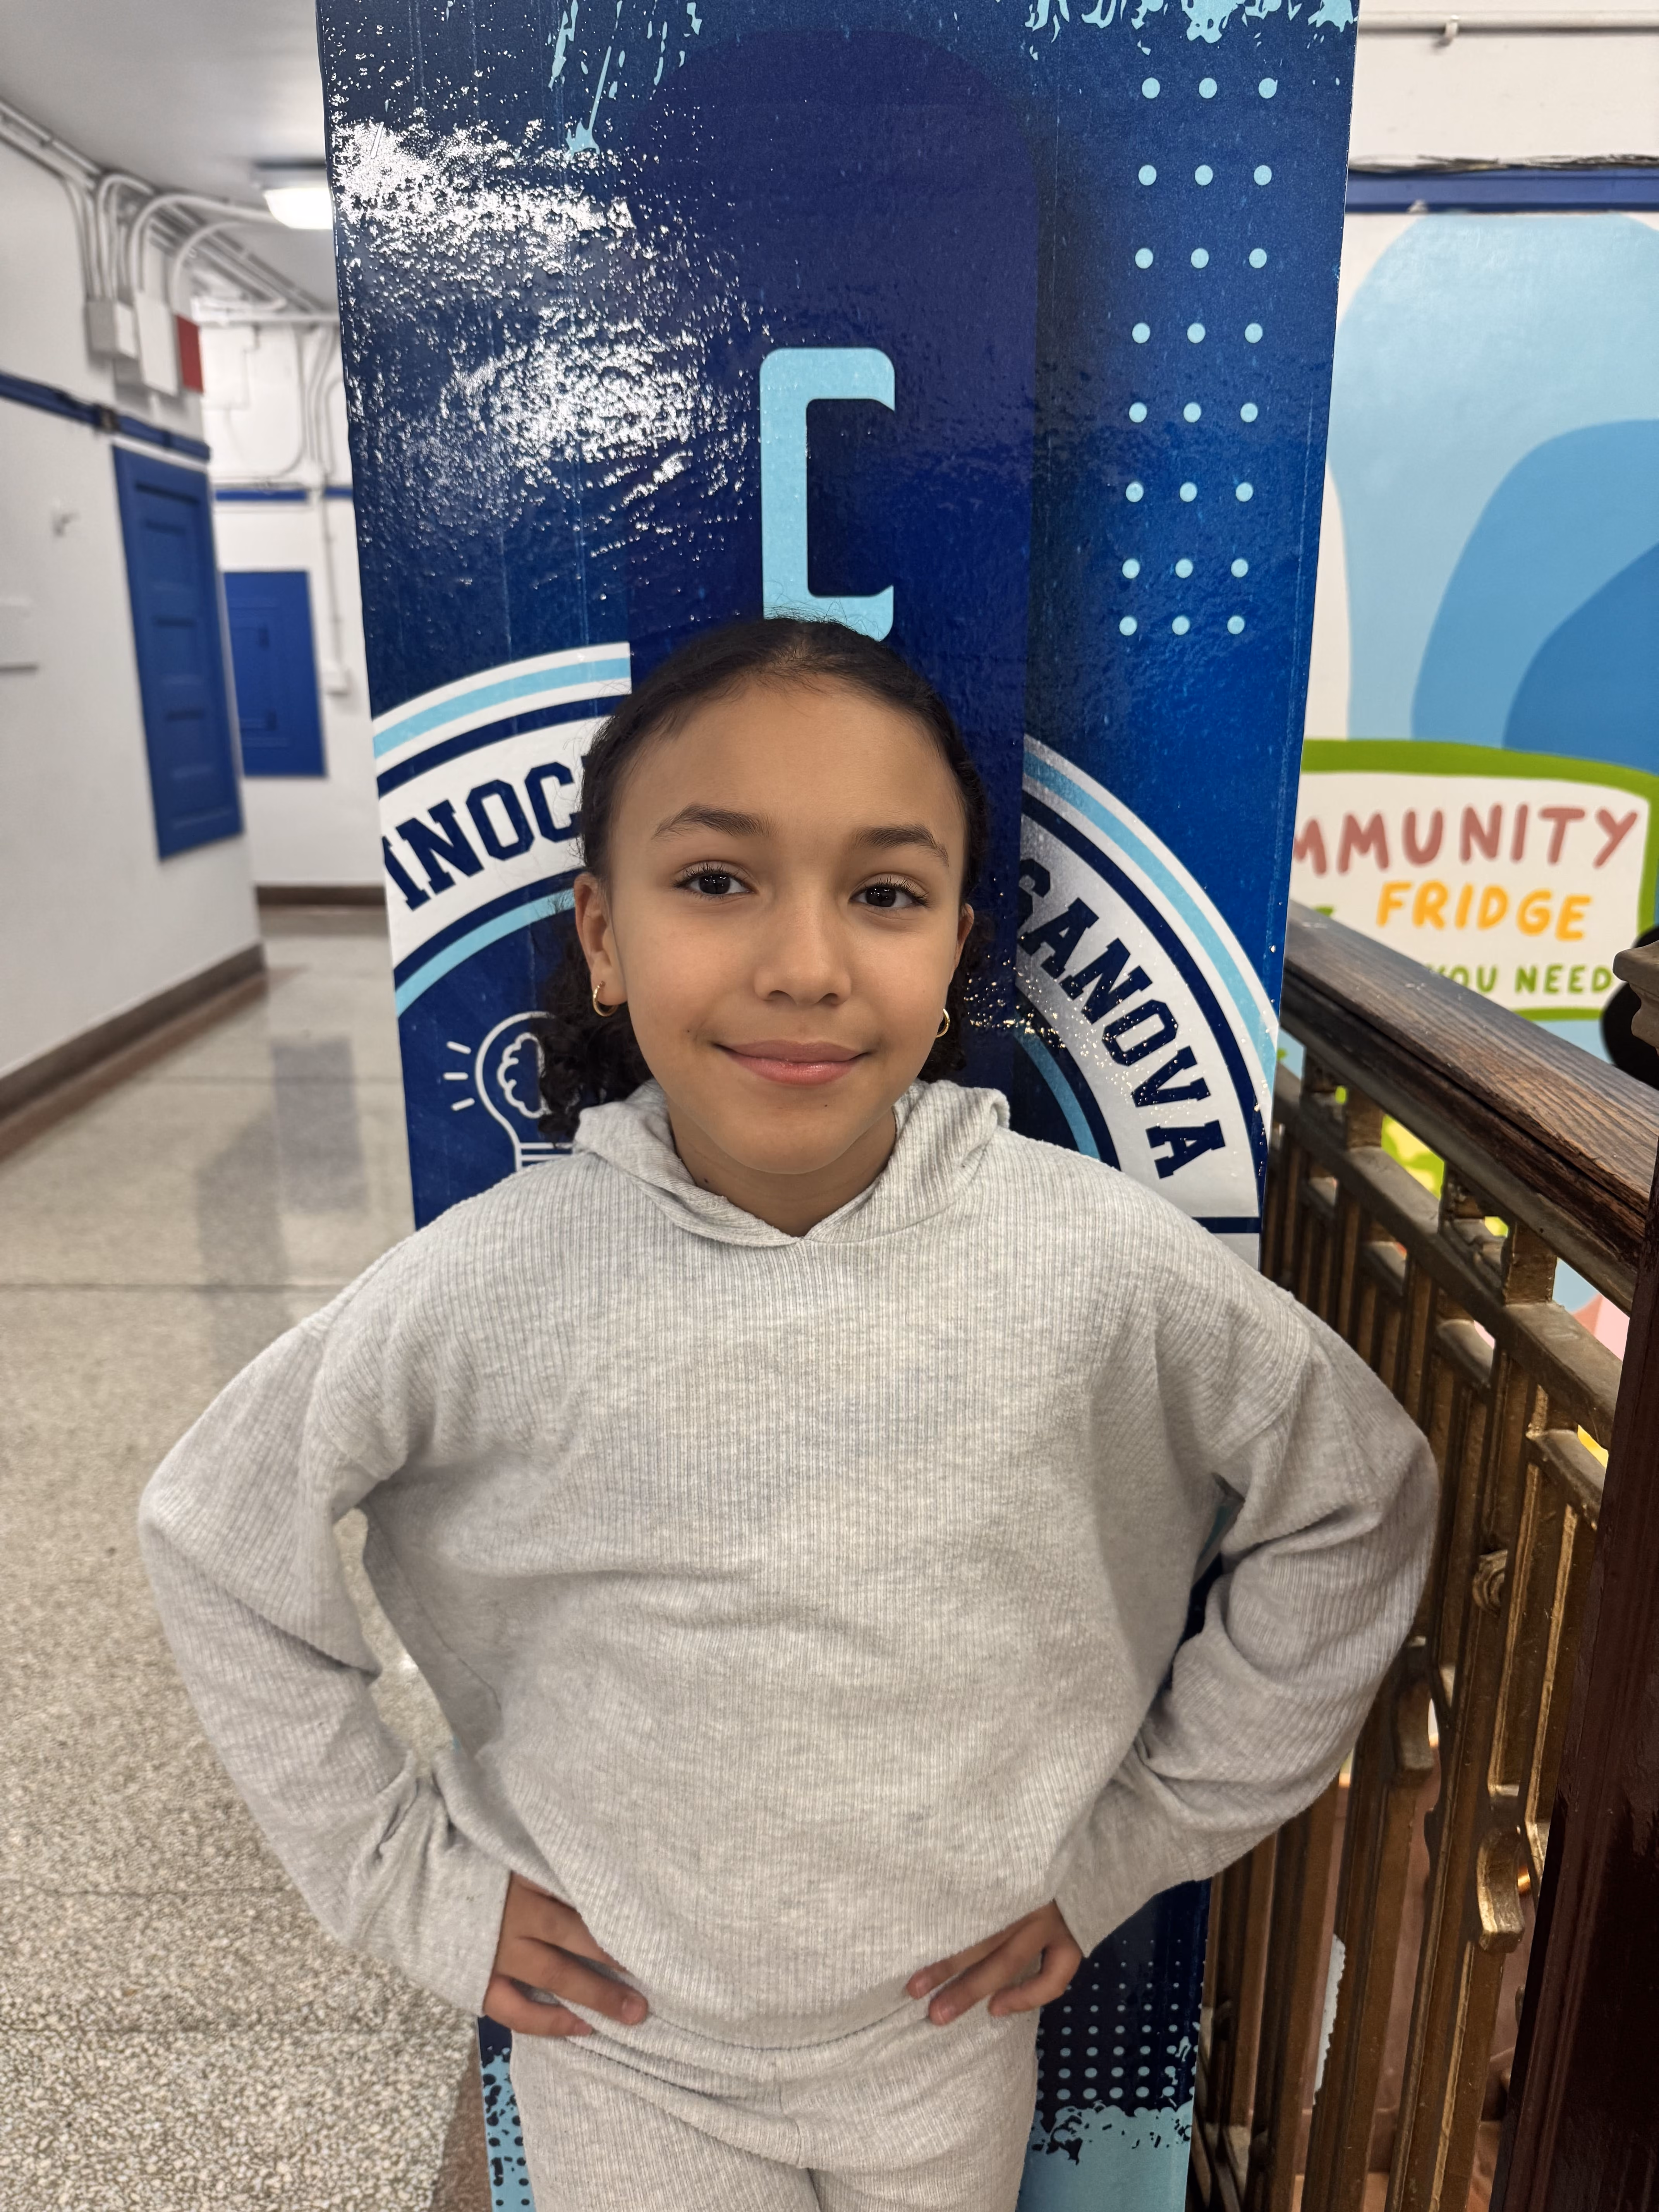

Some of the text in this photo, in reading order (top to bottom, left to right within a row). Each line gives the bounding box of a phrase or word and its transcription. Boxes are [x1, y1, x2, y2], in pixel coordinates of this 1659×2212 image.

[382, 755, 586, 912] INOC
[1377, 880, 1592, 941] FRIDGE
[1514, 965, 1613, 994] NEED
